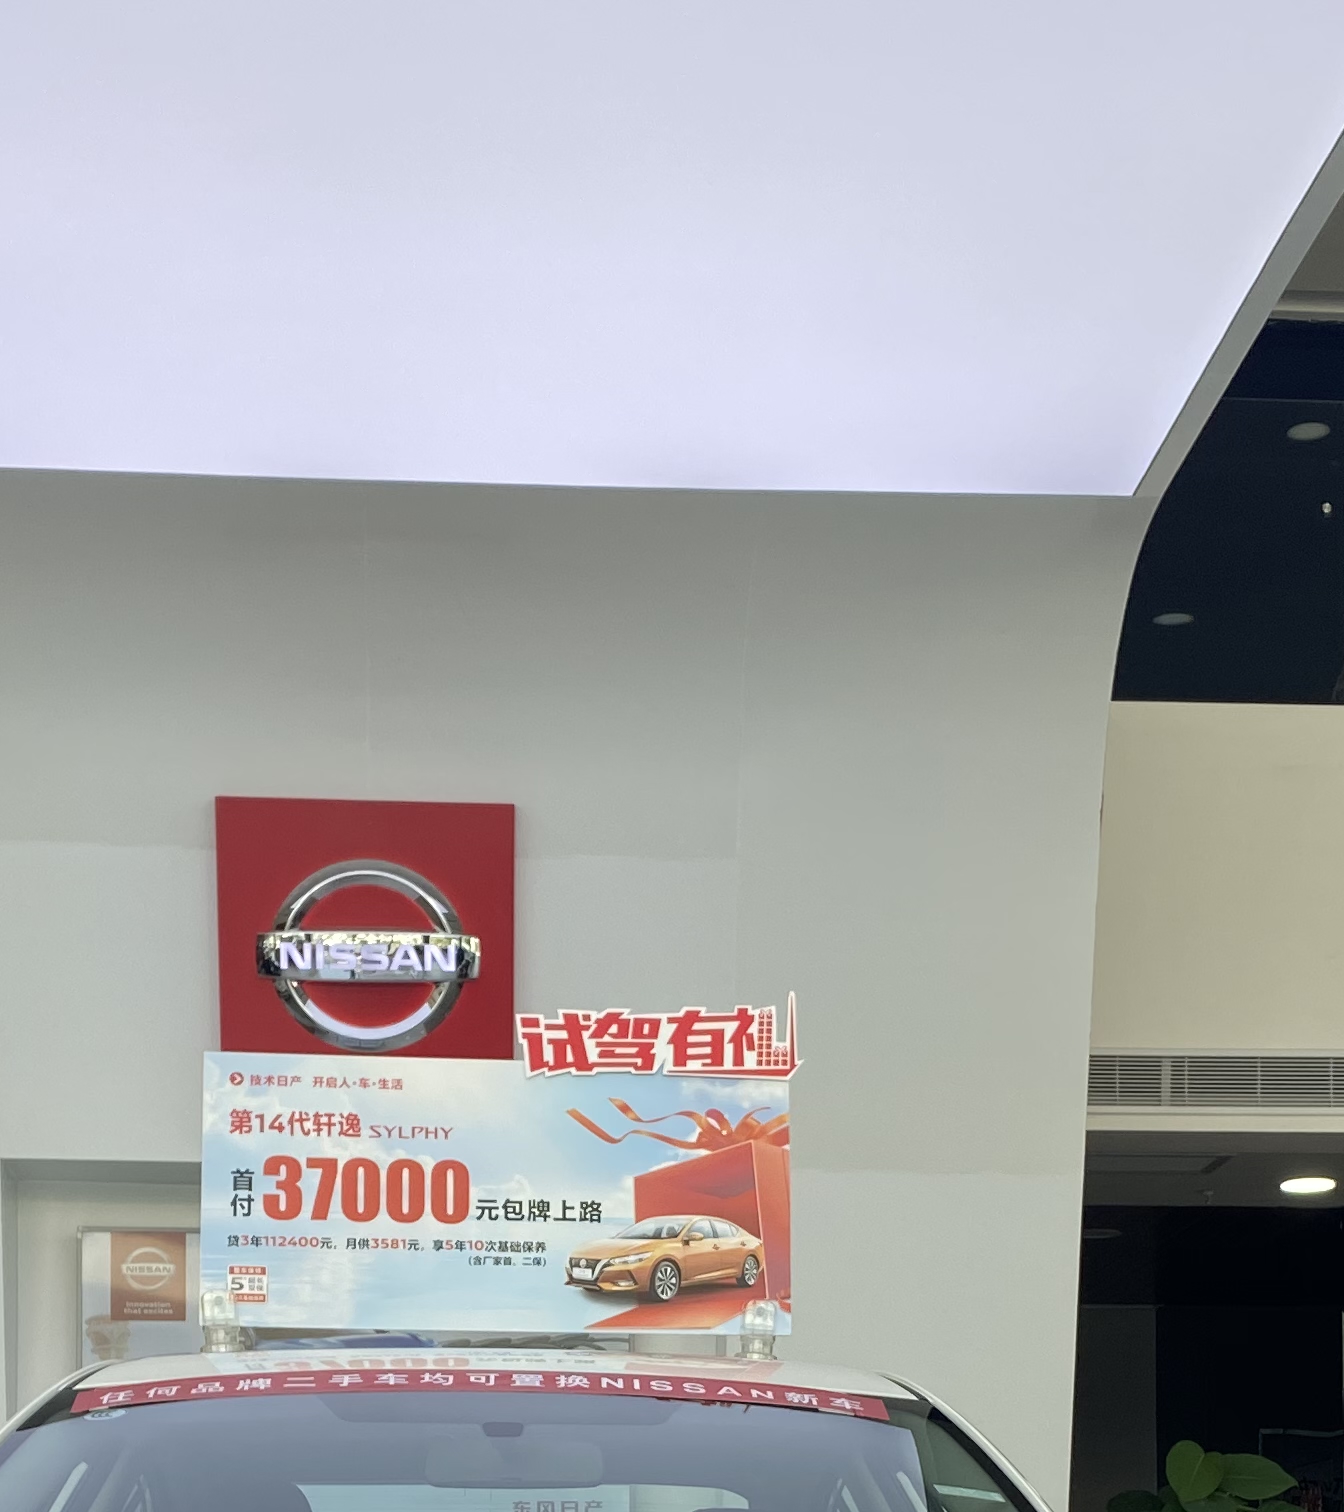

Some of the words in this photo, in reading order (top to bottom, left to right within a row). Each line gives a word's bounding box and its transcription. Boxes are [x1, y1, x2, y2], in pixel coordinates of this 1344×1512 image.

[279, 942, 457, 973] NISSAN
[518, 992, 800, 1077] 试驾有礼
[250, 1074, 302, 1087] 技术日产
[229, 1108, 362, 1138] 第14代轩逸
[368, 1124, 455, 1141] SYLPHY
[262, 1154, 471, 1225] 37000
[475, 1199, 603, 1224] 元包牌上路
[125, 1265, 172, 1274] NISSAN
